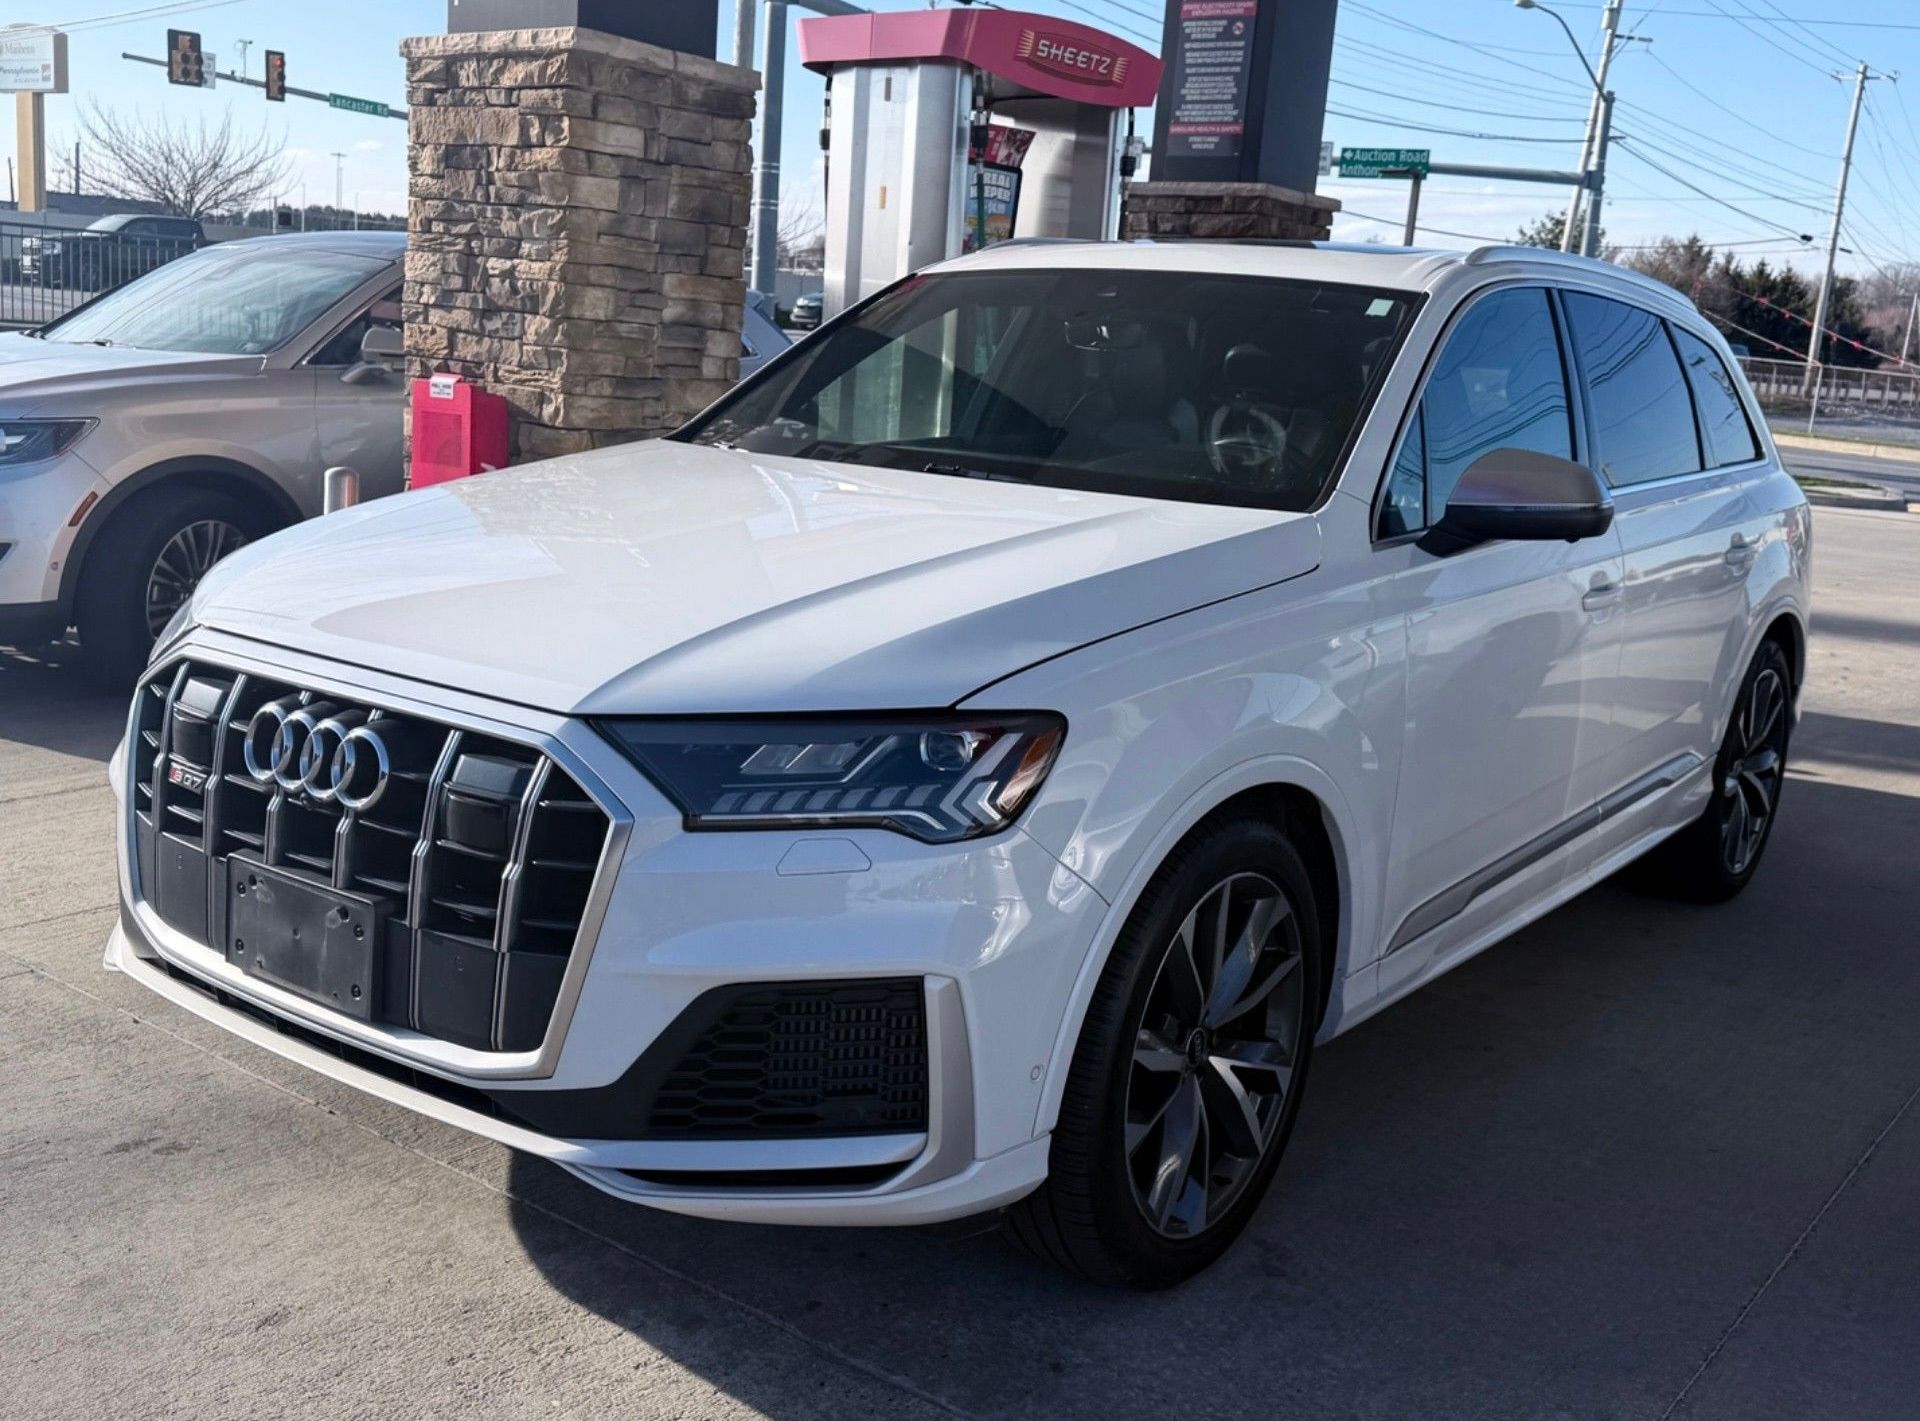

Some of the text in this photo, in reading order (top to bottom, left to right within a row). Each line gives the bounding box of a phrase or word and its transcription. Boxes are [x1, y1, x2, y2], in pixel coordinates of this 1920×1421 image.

[1036, 39, 1111, 74] SHEETZ
[1353, 149, 1429, 162] Auction Road
